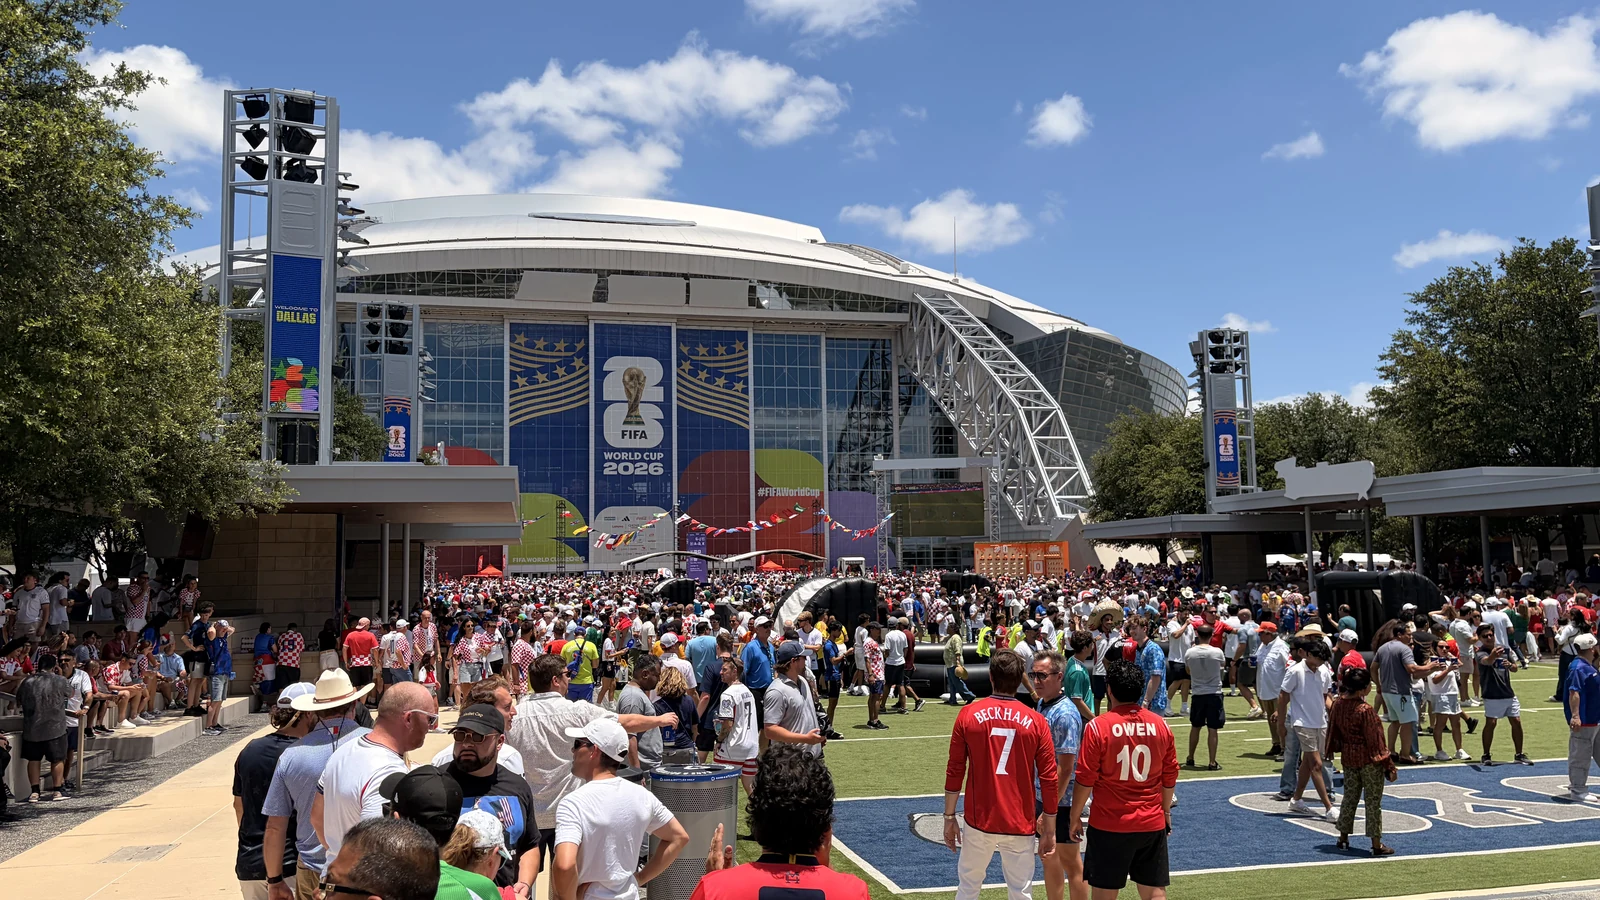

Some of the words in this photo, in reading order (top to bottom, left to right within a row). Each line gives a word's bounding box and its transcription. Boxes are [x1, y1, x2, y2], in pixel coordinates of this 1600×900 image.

[276, 310, 316, 324] DALLAS
[621, 430, 648, 440] FIFA
[604, 452, 642, 460] WORLD
[643, 452, 664, 460] CUP
[603, 462, 664, 476] 2026
[758, 487, 820, 497] #FIFAWorldCup
[744, 702, 752, 730] 7
[973, 706, 1033, 730] BECKHAM
[1112, 722, 1156, 738] OWEN
[990, 727, 1017, 775] 7
[1116, 744, 1151, 782] 10
